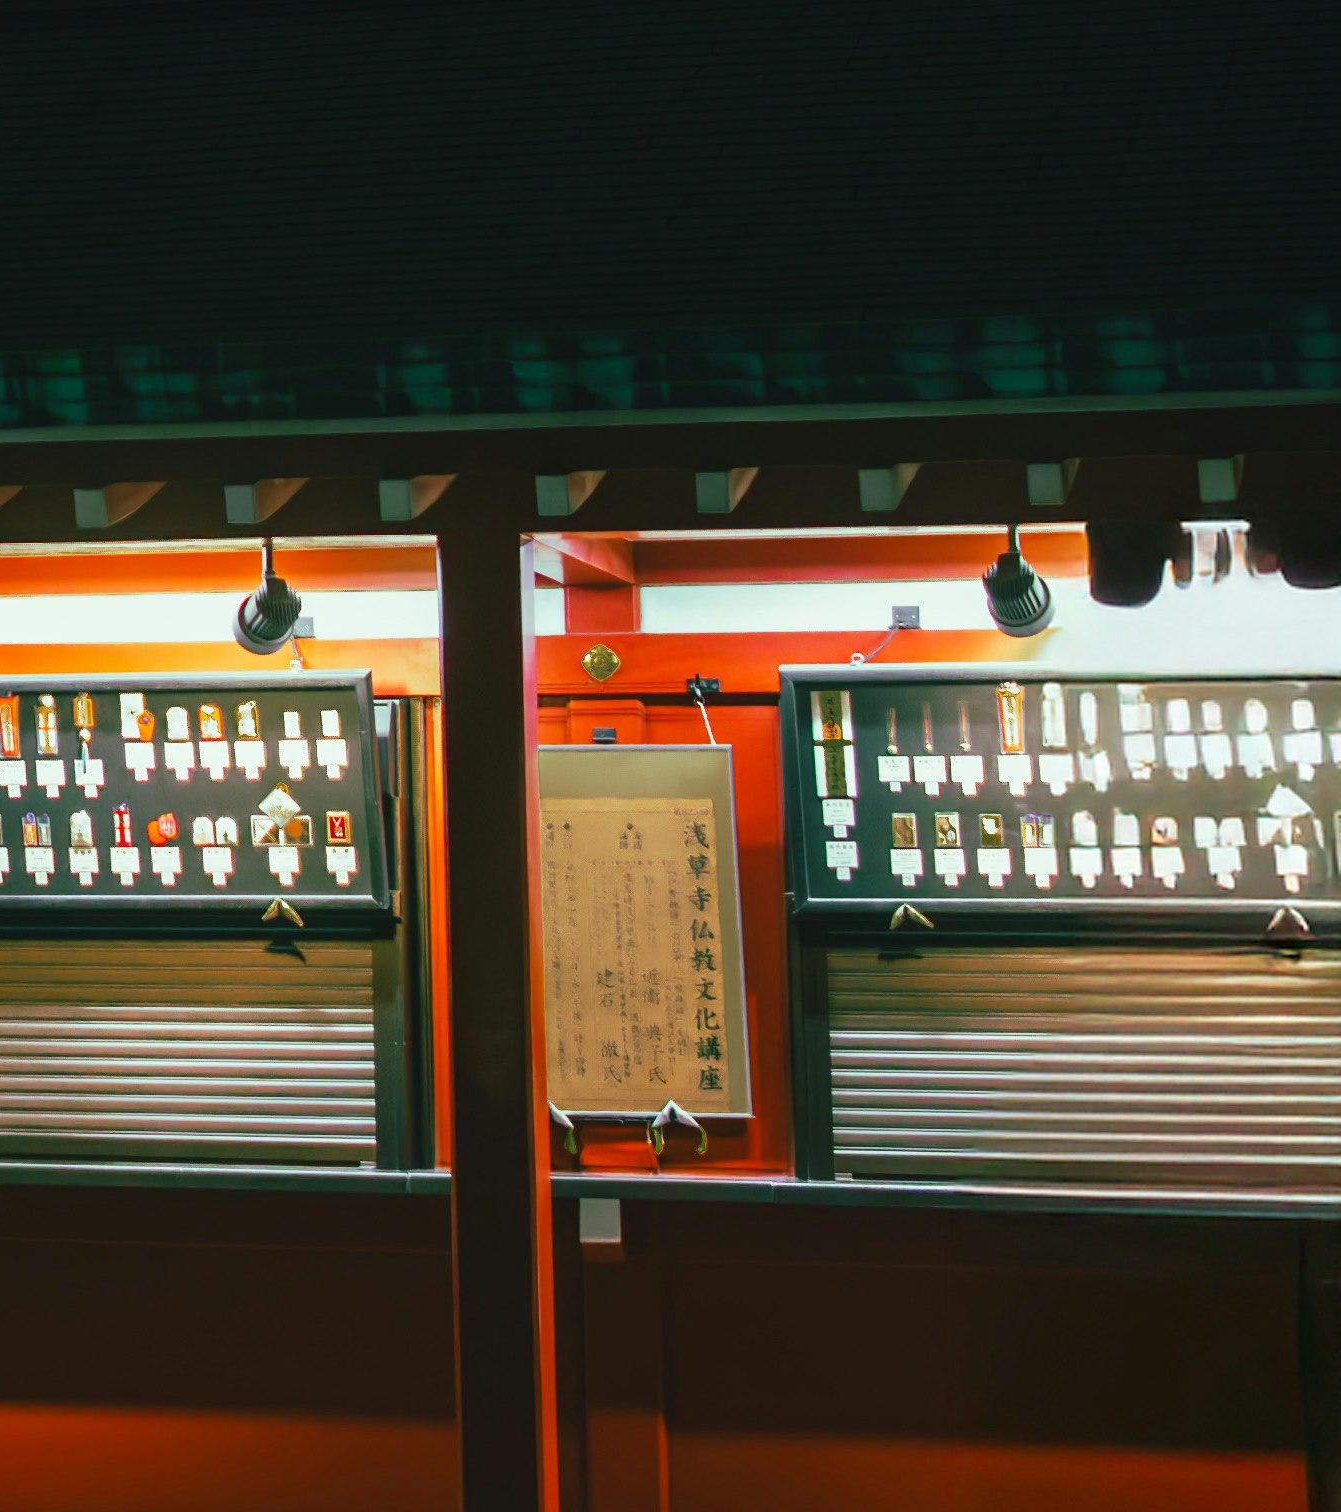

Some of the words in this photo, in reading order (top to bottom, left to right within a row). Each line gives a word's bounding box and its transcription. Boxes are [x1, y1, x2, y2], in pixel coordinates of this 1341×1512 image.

[683, 821, 724, 1092] 浅草寺仏教文化講座
